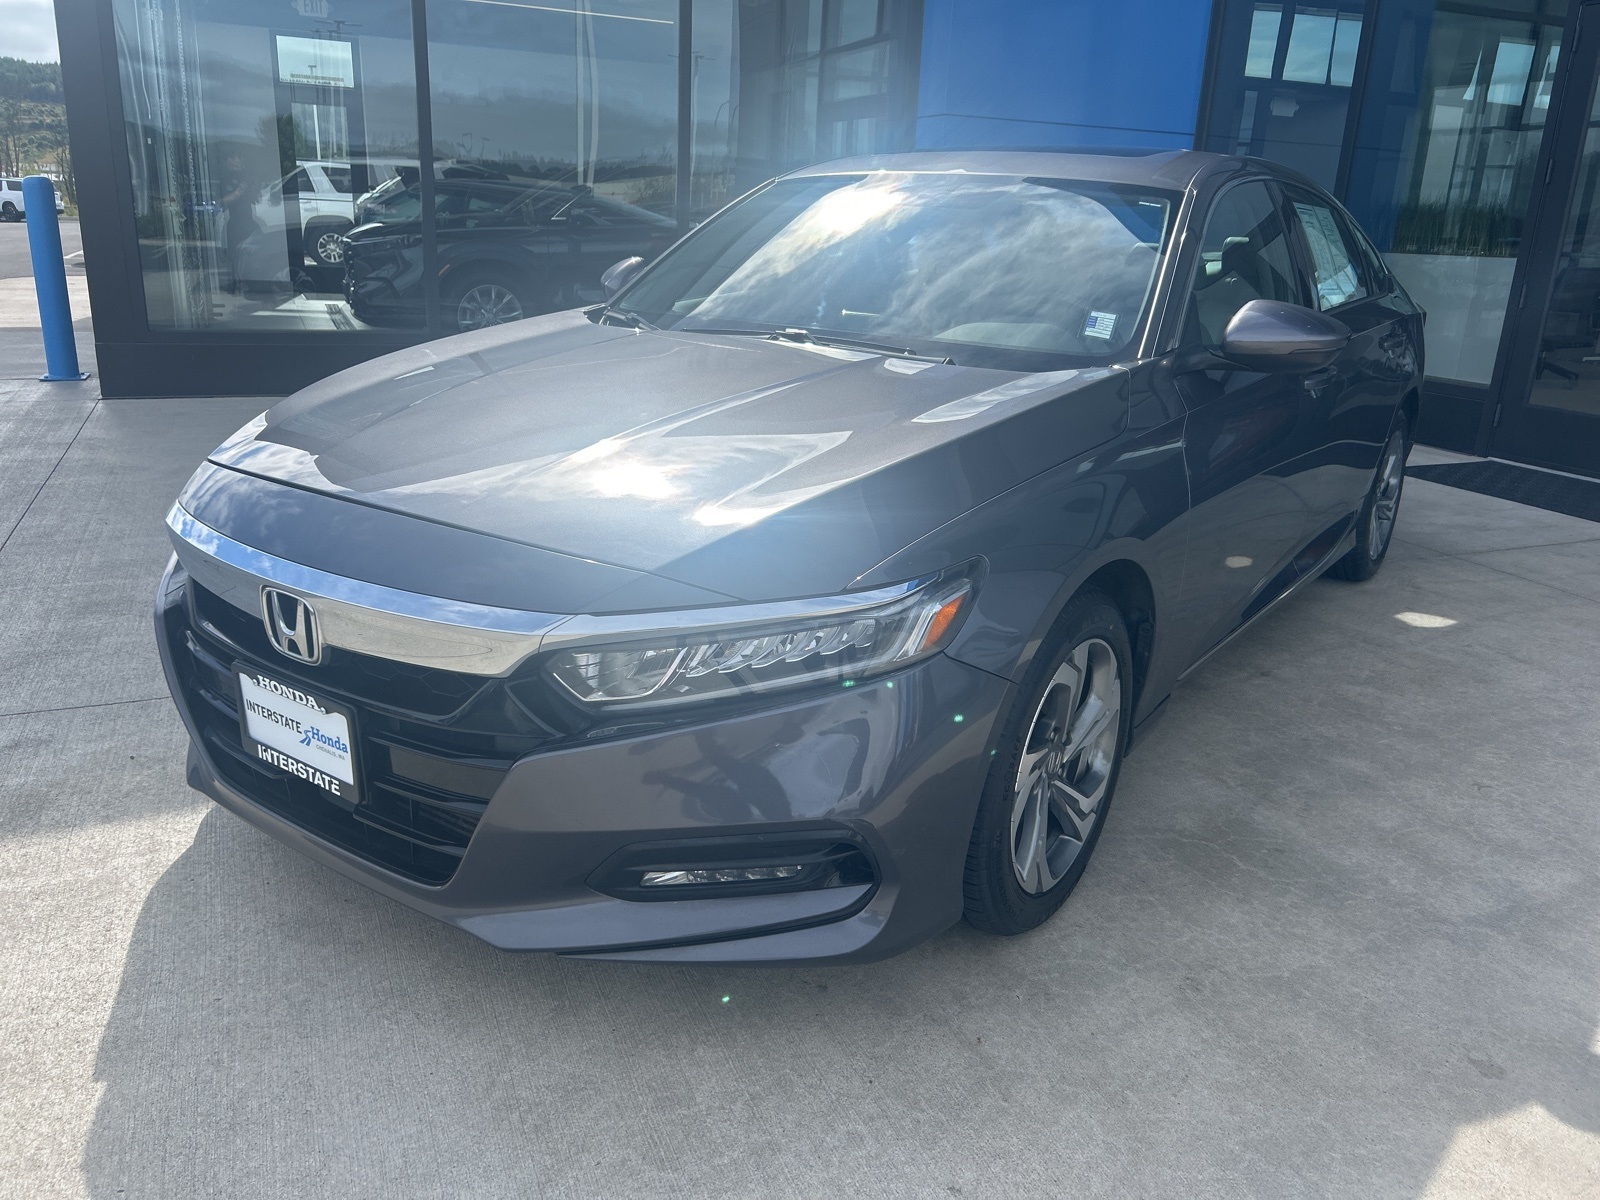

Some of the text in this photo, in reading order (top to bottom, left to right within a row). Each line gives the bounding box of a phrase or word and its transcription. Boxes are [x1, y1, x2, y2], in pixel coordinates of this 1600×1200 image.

[303, 0, 323, 14] EXIT
[257, 675, 320, 710] HONDA
[246, 699, 348, 754] INTERSTATE Honda
[257, 744, 341, 796] INTERSTATE
